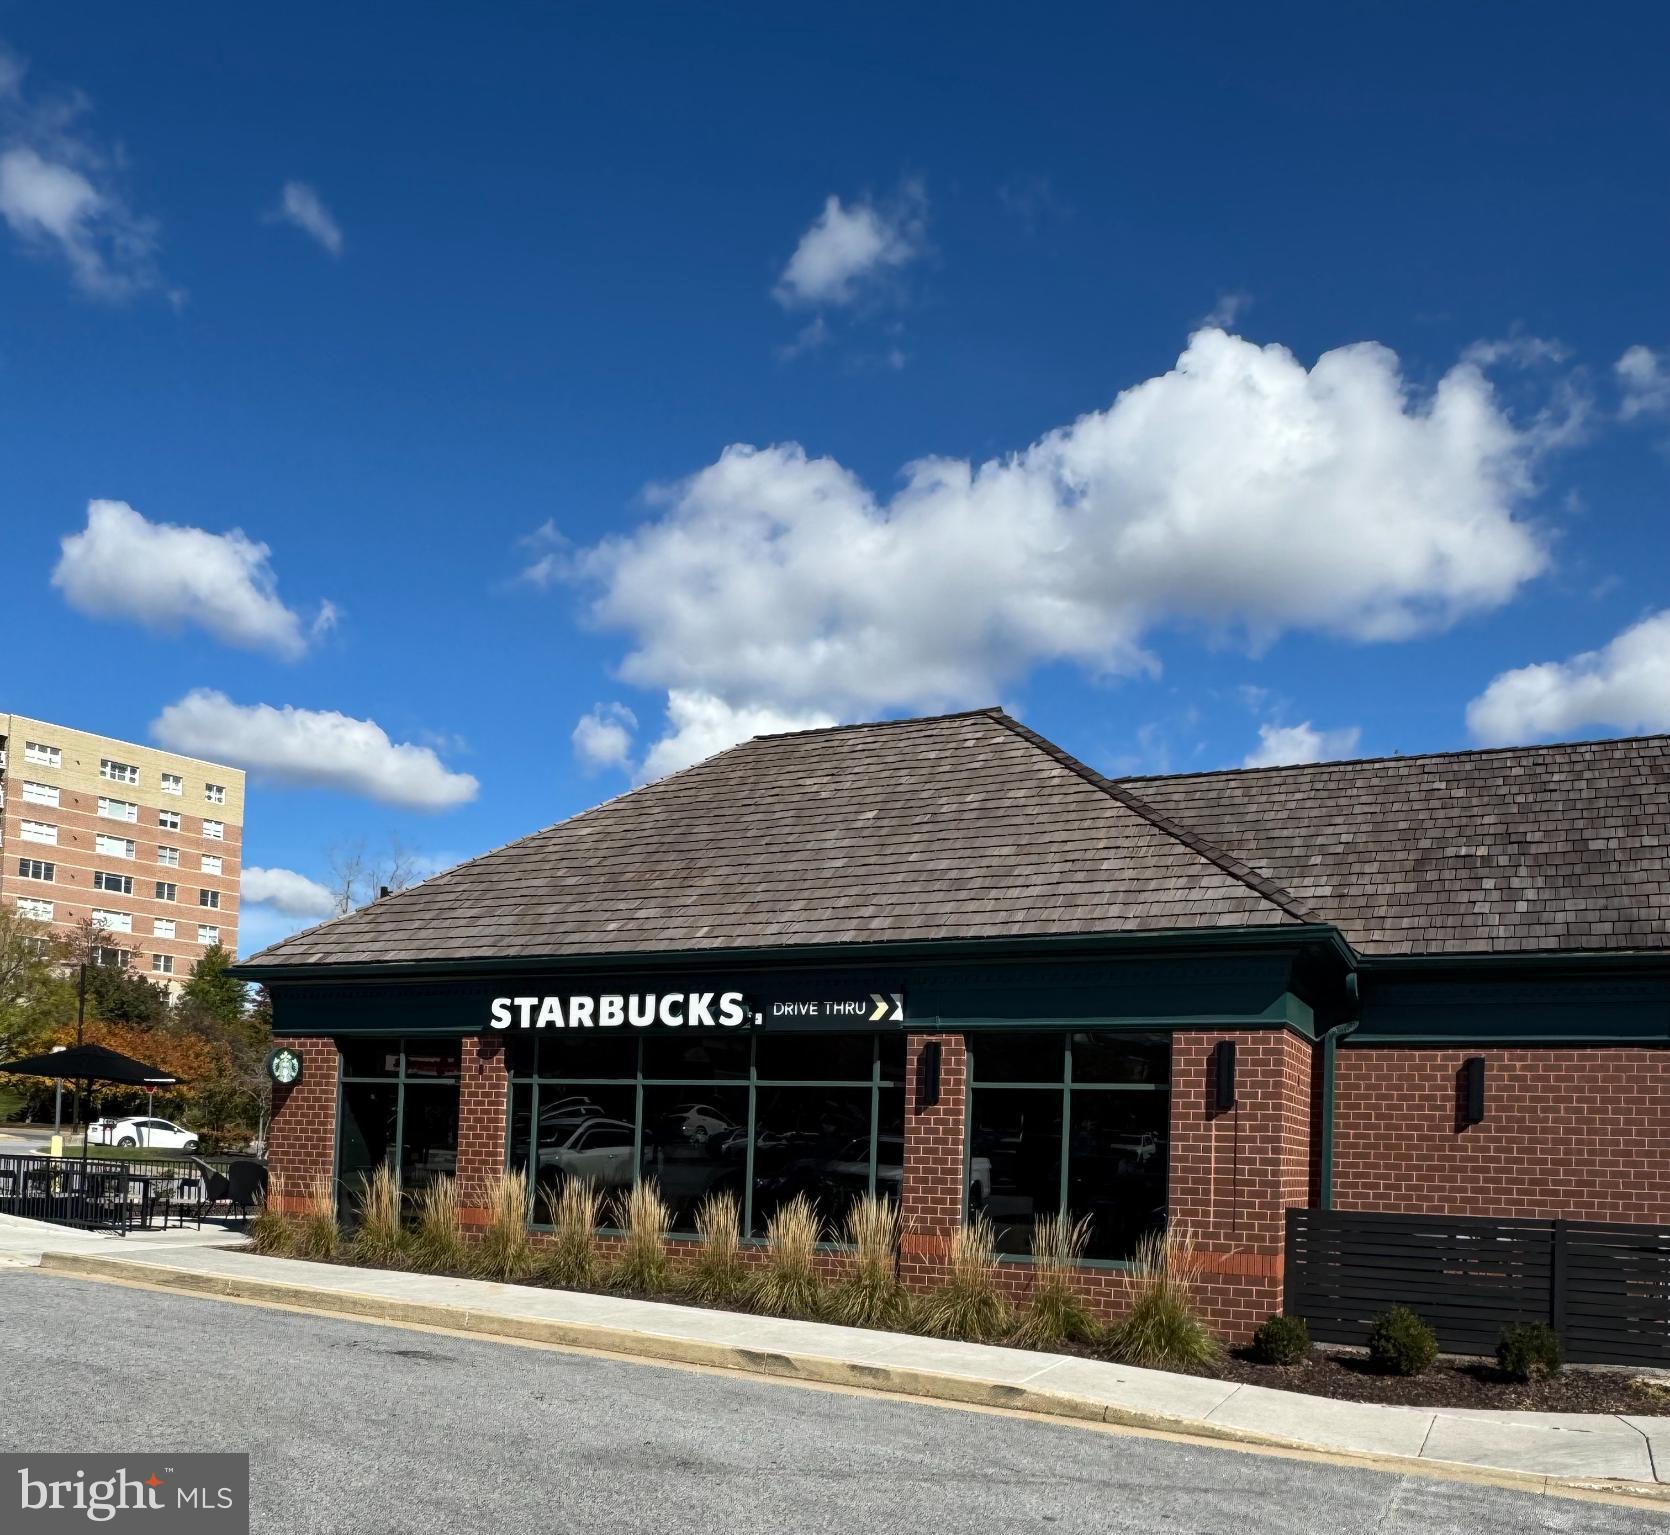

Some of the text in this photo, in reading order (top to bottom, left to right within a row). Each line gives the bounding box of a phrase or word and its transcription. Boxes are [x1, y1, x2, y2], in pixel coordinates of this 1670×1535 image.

[490, 992, 744, 1029] STARBUCKS
[773, 1001, 866, 1016] DRIVE THRU
